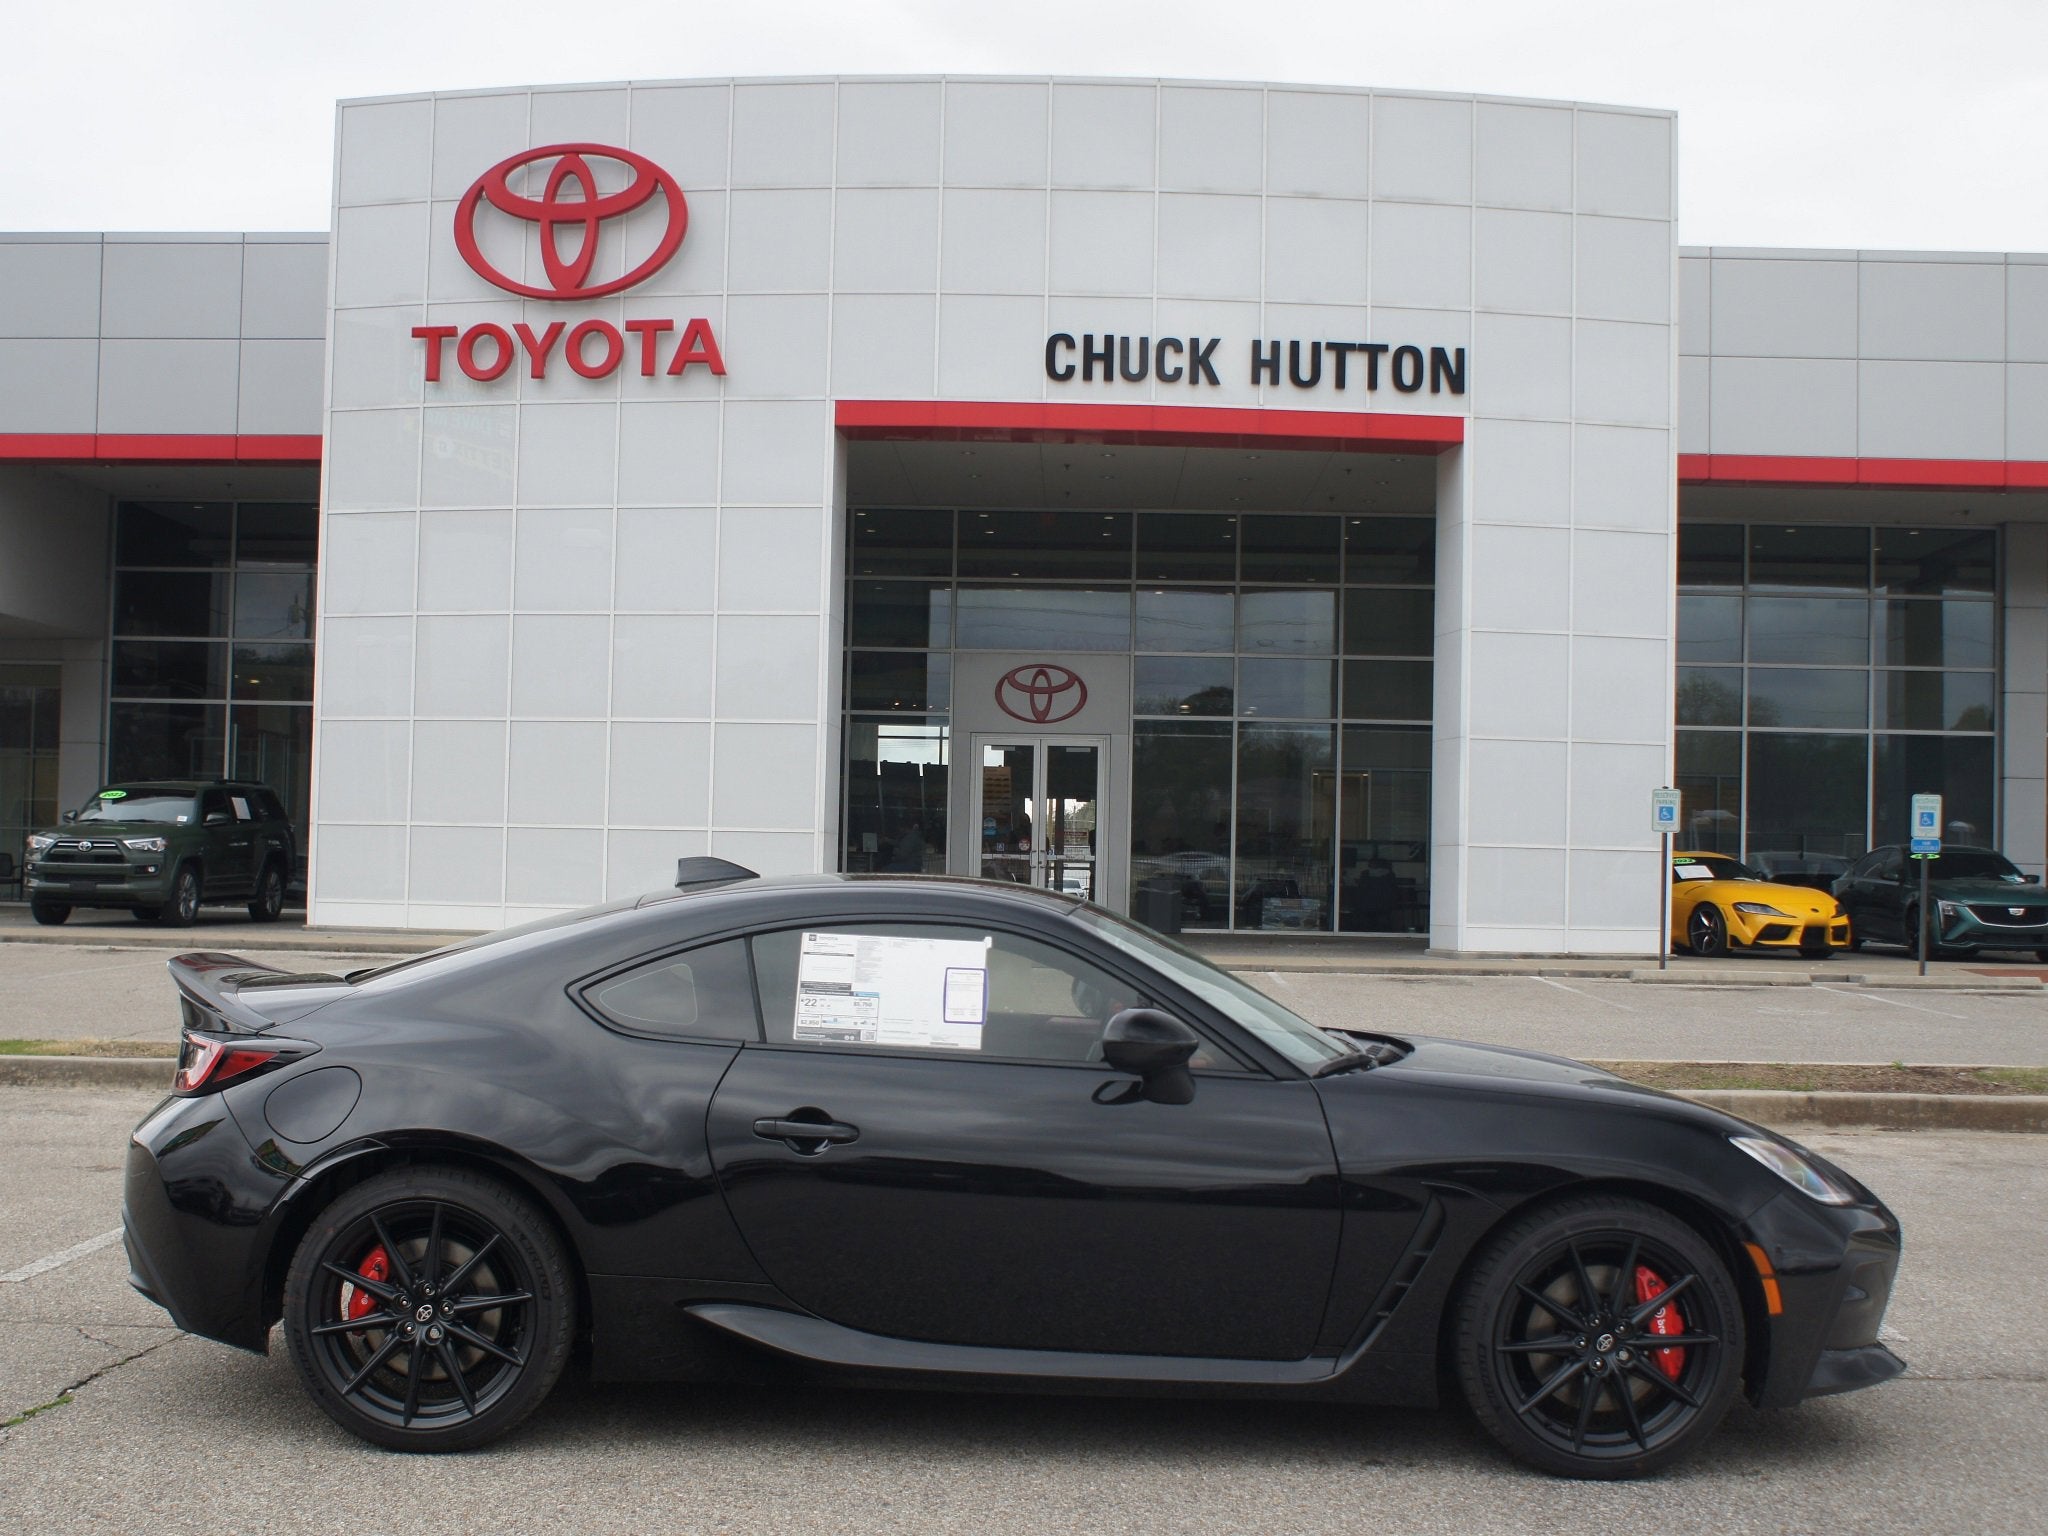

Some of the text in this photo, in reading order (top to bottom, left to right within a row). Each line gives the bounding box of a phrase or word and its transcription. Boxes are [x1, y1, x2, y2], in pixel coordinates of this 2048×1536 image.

[411, 317, 727, 382] TOYOTA
[1045, 332, 1466, 395] CHUCK HUTTON
